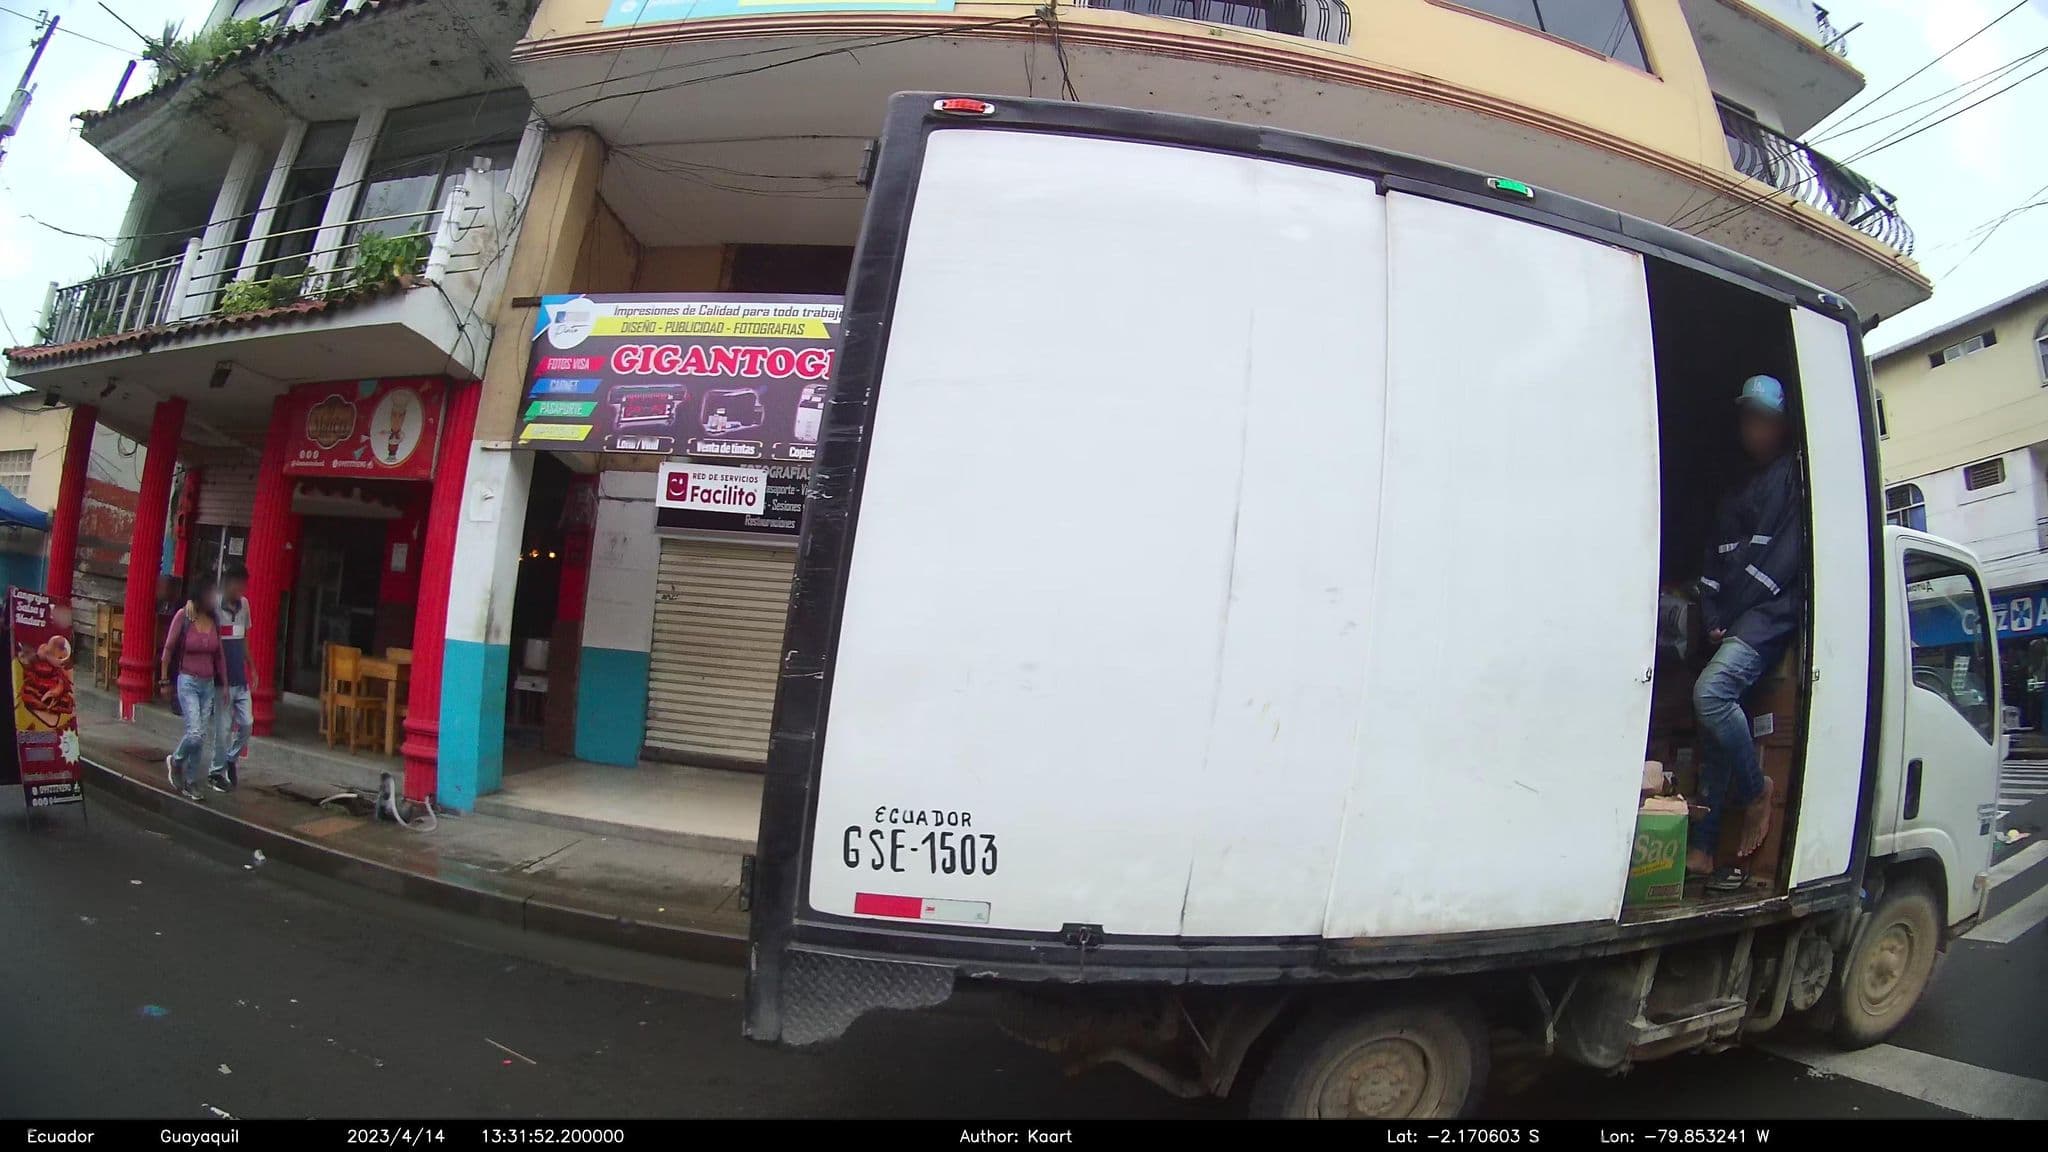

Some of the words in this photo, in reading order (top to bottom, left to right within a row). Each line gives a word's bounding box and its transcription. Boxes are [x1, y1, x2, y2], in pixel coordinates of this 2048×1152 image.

[614, 304, 680, 318] Impresiones
[682, 305, 696, 316] de
[699, 304, 741, 317] Calidad
[742, 307, 770, 319] para
[773, 306, 799, 317] todo
[621, 320, 657, 334] DISEÑO
[664, 321, 725, 334] PUBLICIDAD
[733, 322, 806, 336] FOTOGRAFIAS
[547, 357, 572, 370] FOTOS
[572, 357, 590, 370] VISA
[697, 440, 720, 453] Venta
[720, 442, 731, 454] de
[731, 443, 756, 455] tintas
[692, 472, 706, 481] RED
[709, 473, 718, 481] DE
[720, 474, 759, 484] SERVICIOS
[690, 484, 757, 507] Facilito
[875, 806, 972, 827] ECUADOR
[843, 826, 998, 875] GSE-1503
